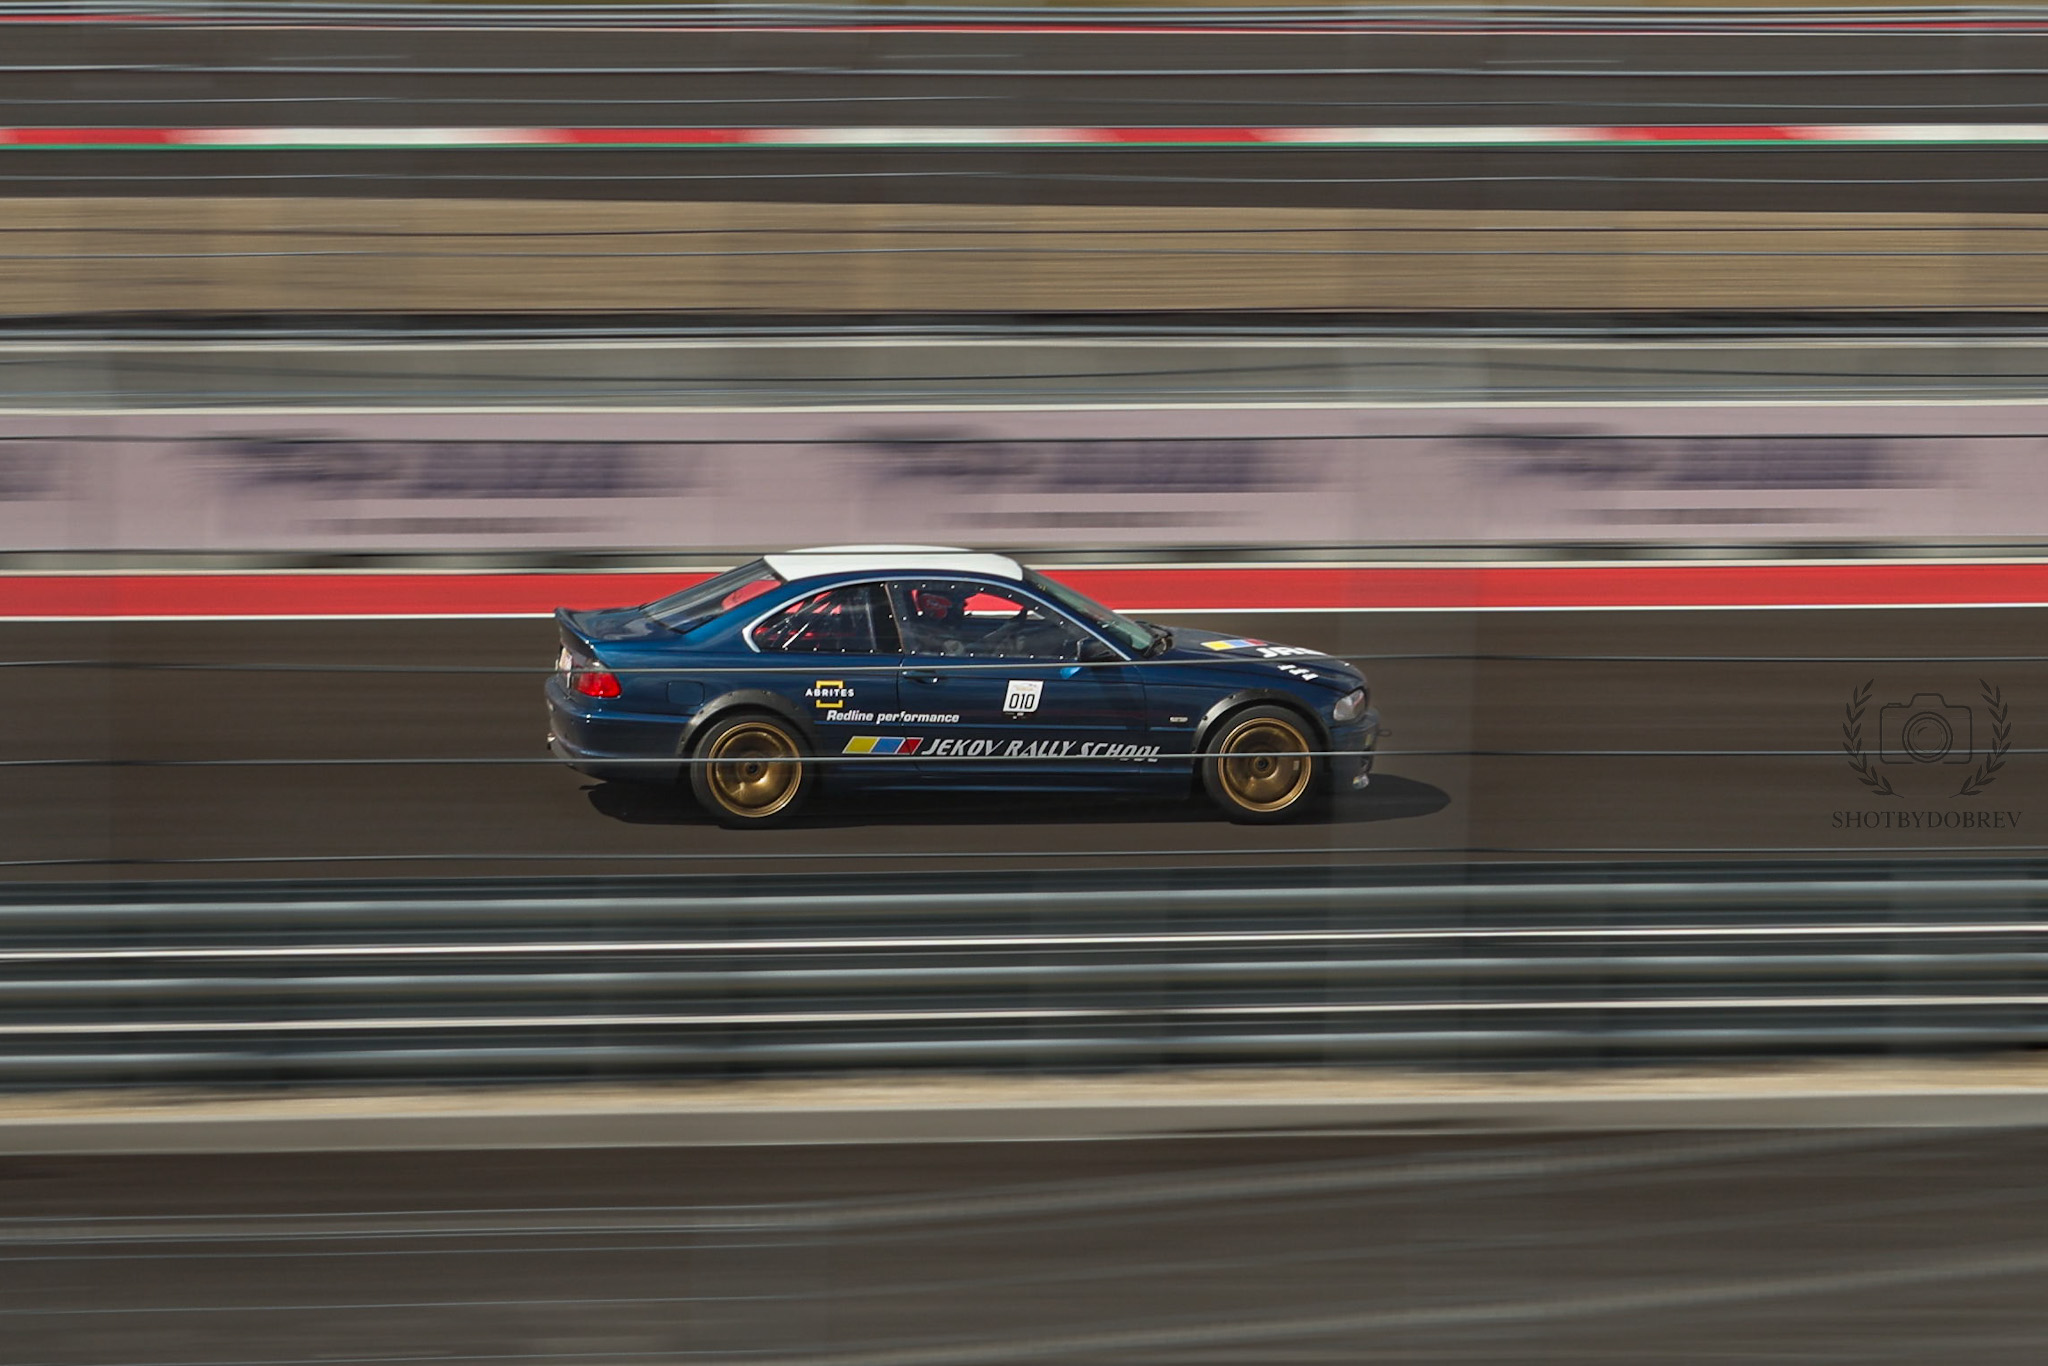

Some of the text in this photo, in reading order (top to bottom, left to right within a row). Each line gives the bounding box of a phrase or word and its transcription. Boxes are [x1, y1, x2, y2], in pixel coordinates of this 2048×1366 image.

[805, 688, 855, 697] ABRITES
[1009, 693, 1035, 709] 010
[826, 710, 960, 725] Redline performance
[921, 738, 1161, 763] JEKOV RALLY SCHOOL
